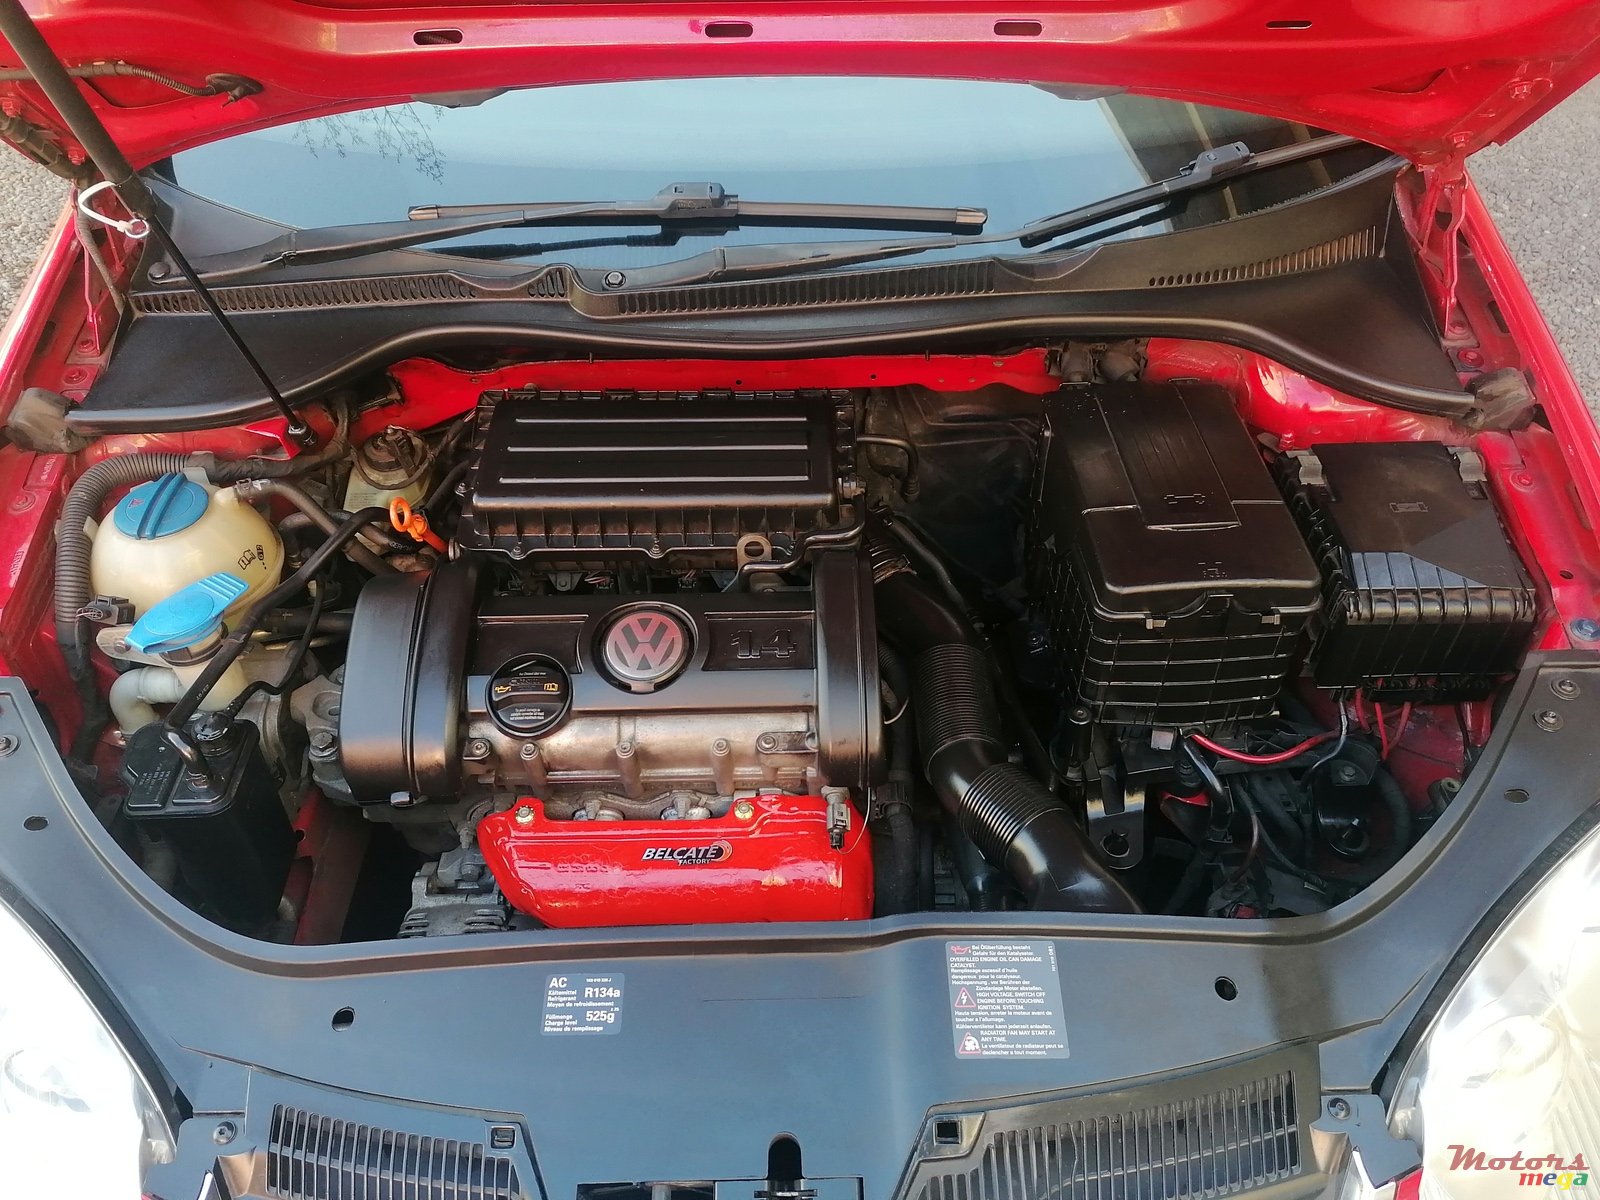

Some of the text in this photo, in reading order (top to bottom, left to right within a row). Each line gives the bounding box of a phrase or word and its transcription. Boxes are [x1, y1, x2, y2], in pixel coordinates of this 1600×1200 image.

[642, 846, 719, 860] BELCATE
[549, 976, 568, 988] AC
[584, 986, 620, 998] R134a
[586, 1010, 615, 1024] 525g
